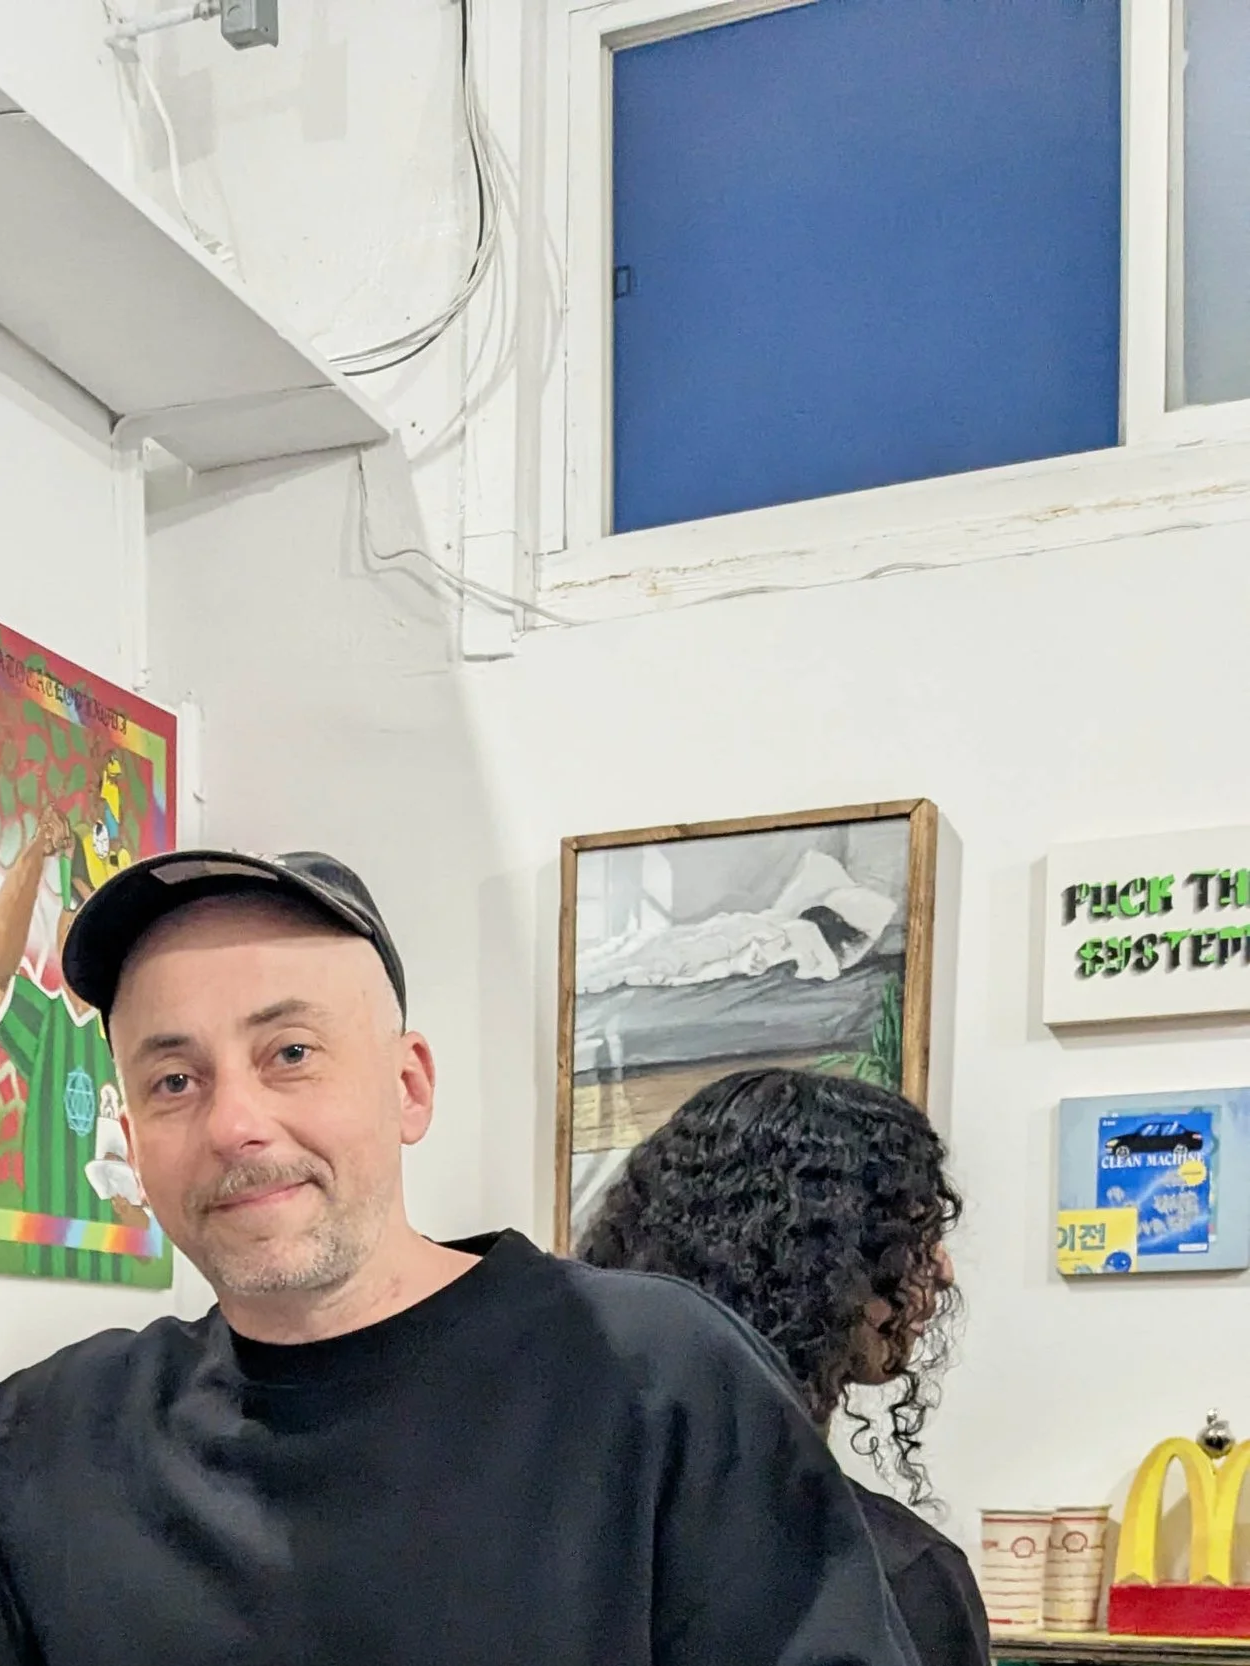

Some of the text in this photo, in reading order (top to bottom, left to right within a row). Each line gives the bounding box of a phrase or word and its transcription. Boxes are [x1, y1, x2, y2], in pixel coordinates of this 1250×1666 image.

[1075, 925, 1250, 978] SYSTEM
[1101, 1153, 1142, 1169] CLEAN
[1057, 1222, 1106, 1252] 이전
